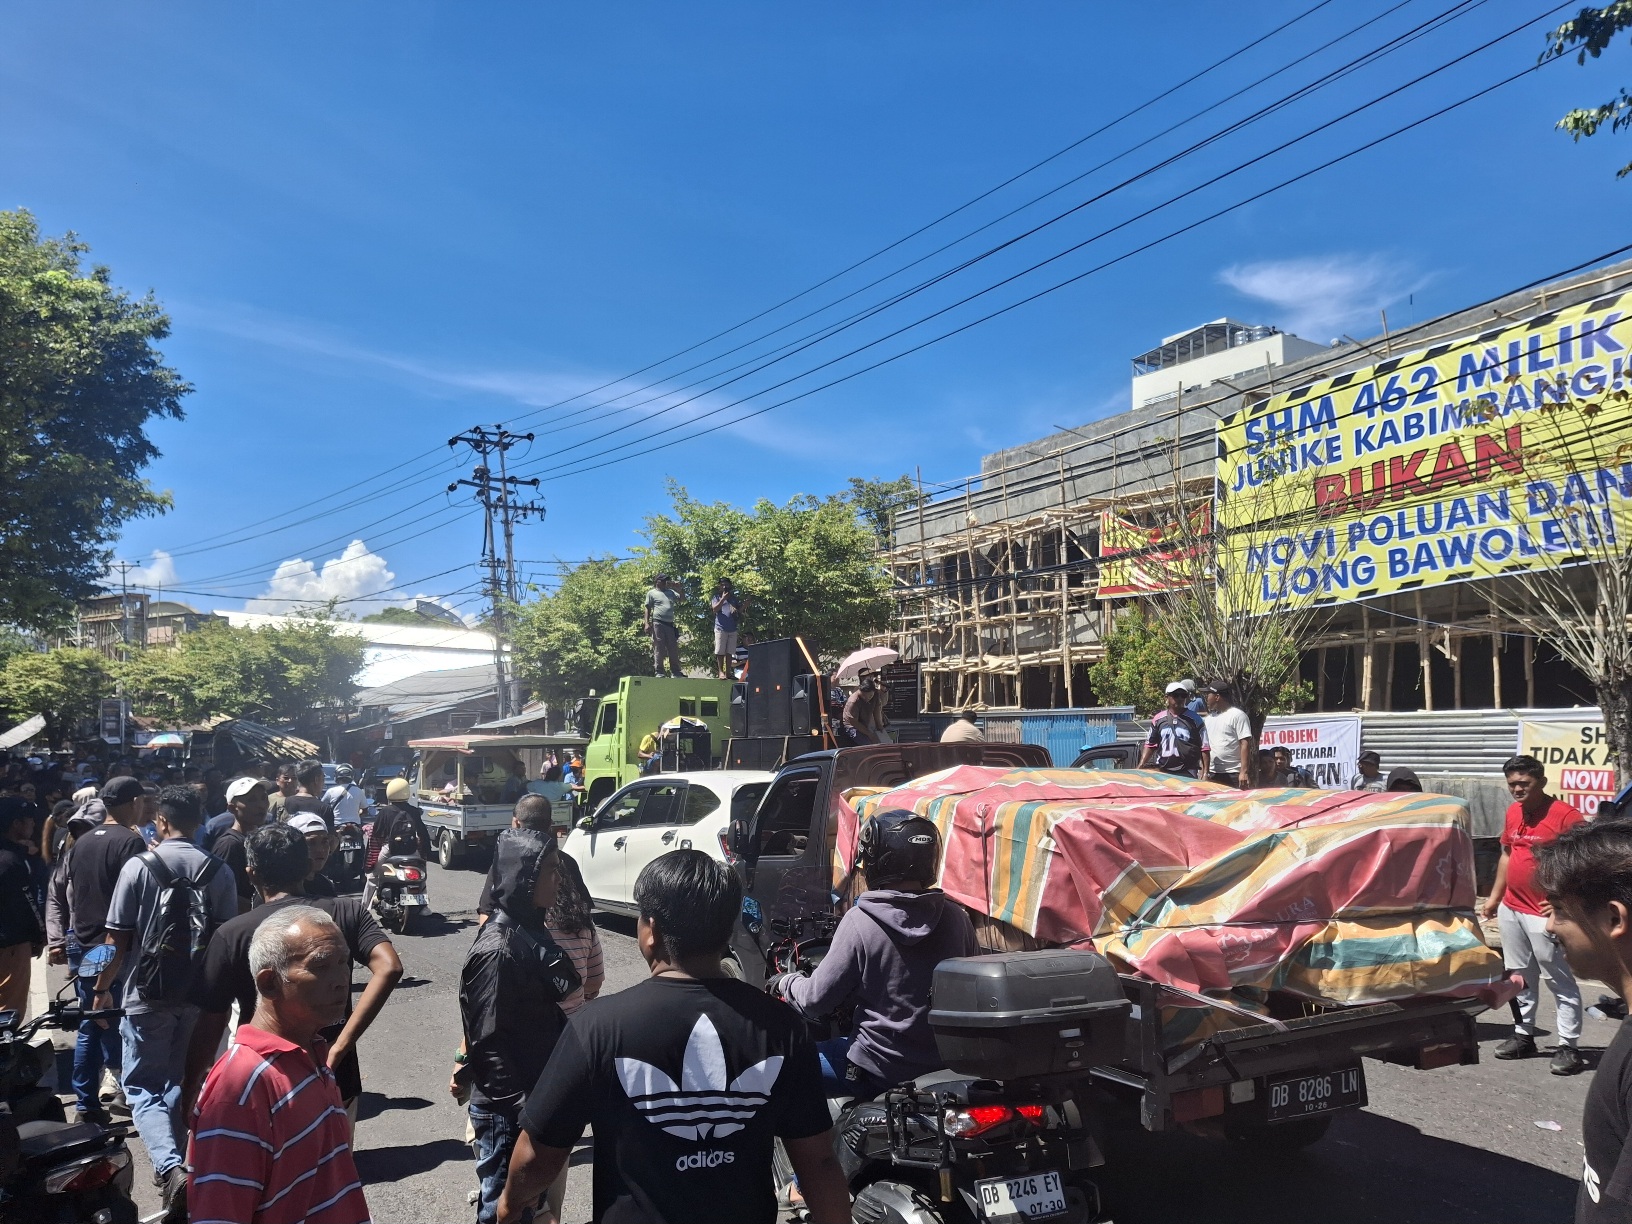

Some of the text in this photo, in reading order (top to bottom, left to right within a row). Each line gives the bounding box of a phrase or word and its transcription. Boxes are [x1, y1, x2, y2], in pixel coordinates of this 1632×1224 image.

[1246, 312, 1625, 455] SHM 462 MILIK
[1232, 354, 1632, 492] JUNIKE KABIMBANG!
[1314, 425, 1524, 516] BUKAN
[1248, 528, 1336, 573] NOVI
[1348, 489, 1511, 552] POLUAN
[1526, 463, 1632, 516] DAN
[1262, 555, 1376, 601] LIONG
[1279, 728, 1318, 744] OBJEK!
[1291, 746, 1337, 760] PERKARA!
[1530, 747, 1597, 766] TIDAK
[1562, 769, 1609, 790] NOVI
[1272, 1070, 1358, 1108] DB 8286 LN
[675, 1149, 735, 1172] adidas
[982, 1173, 1059, 1206] DB 2246 EY
